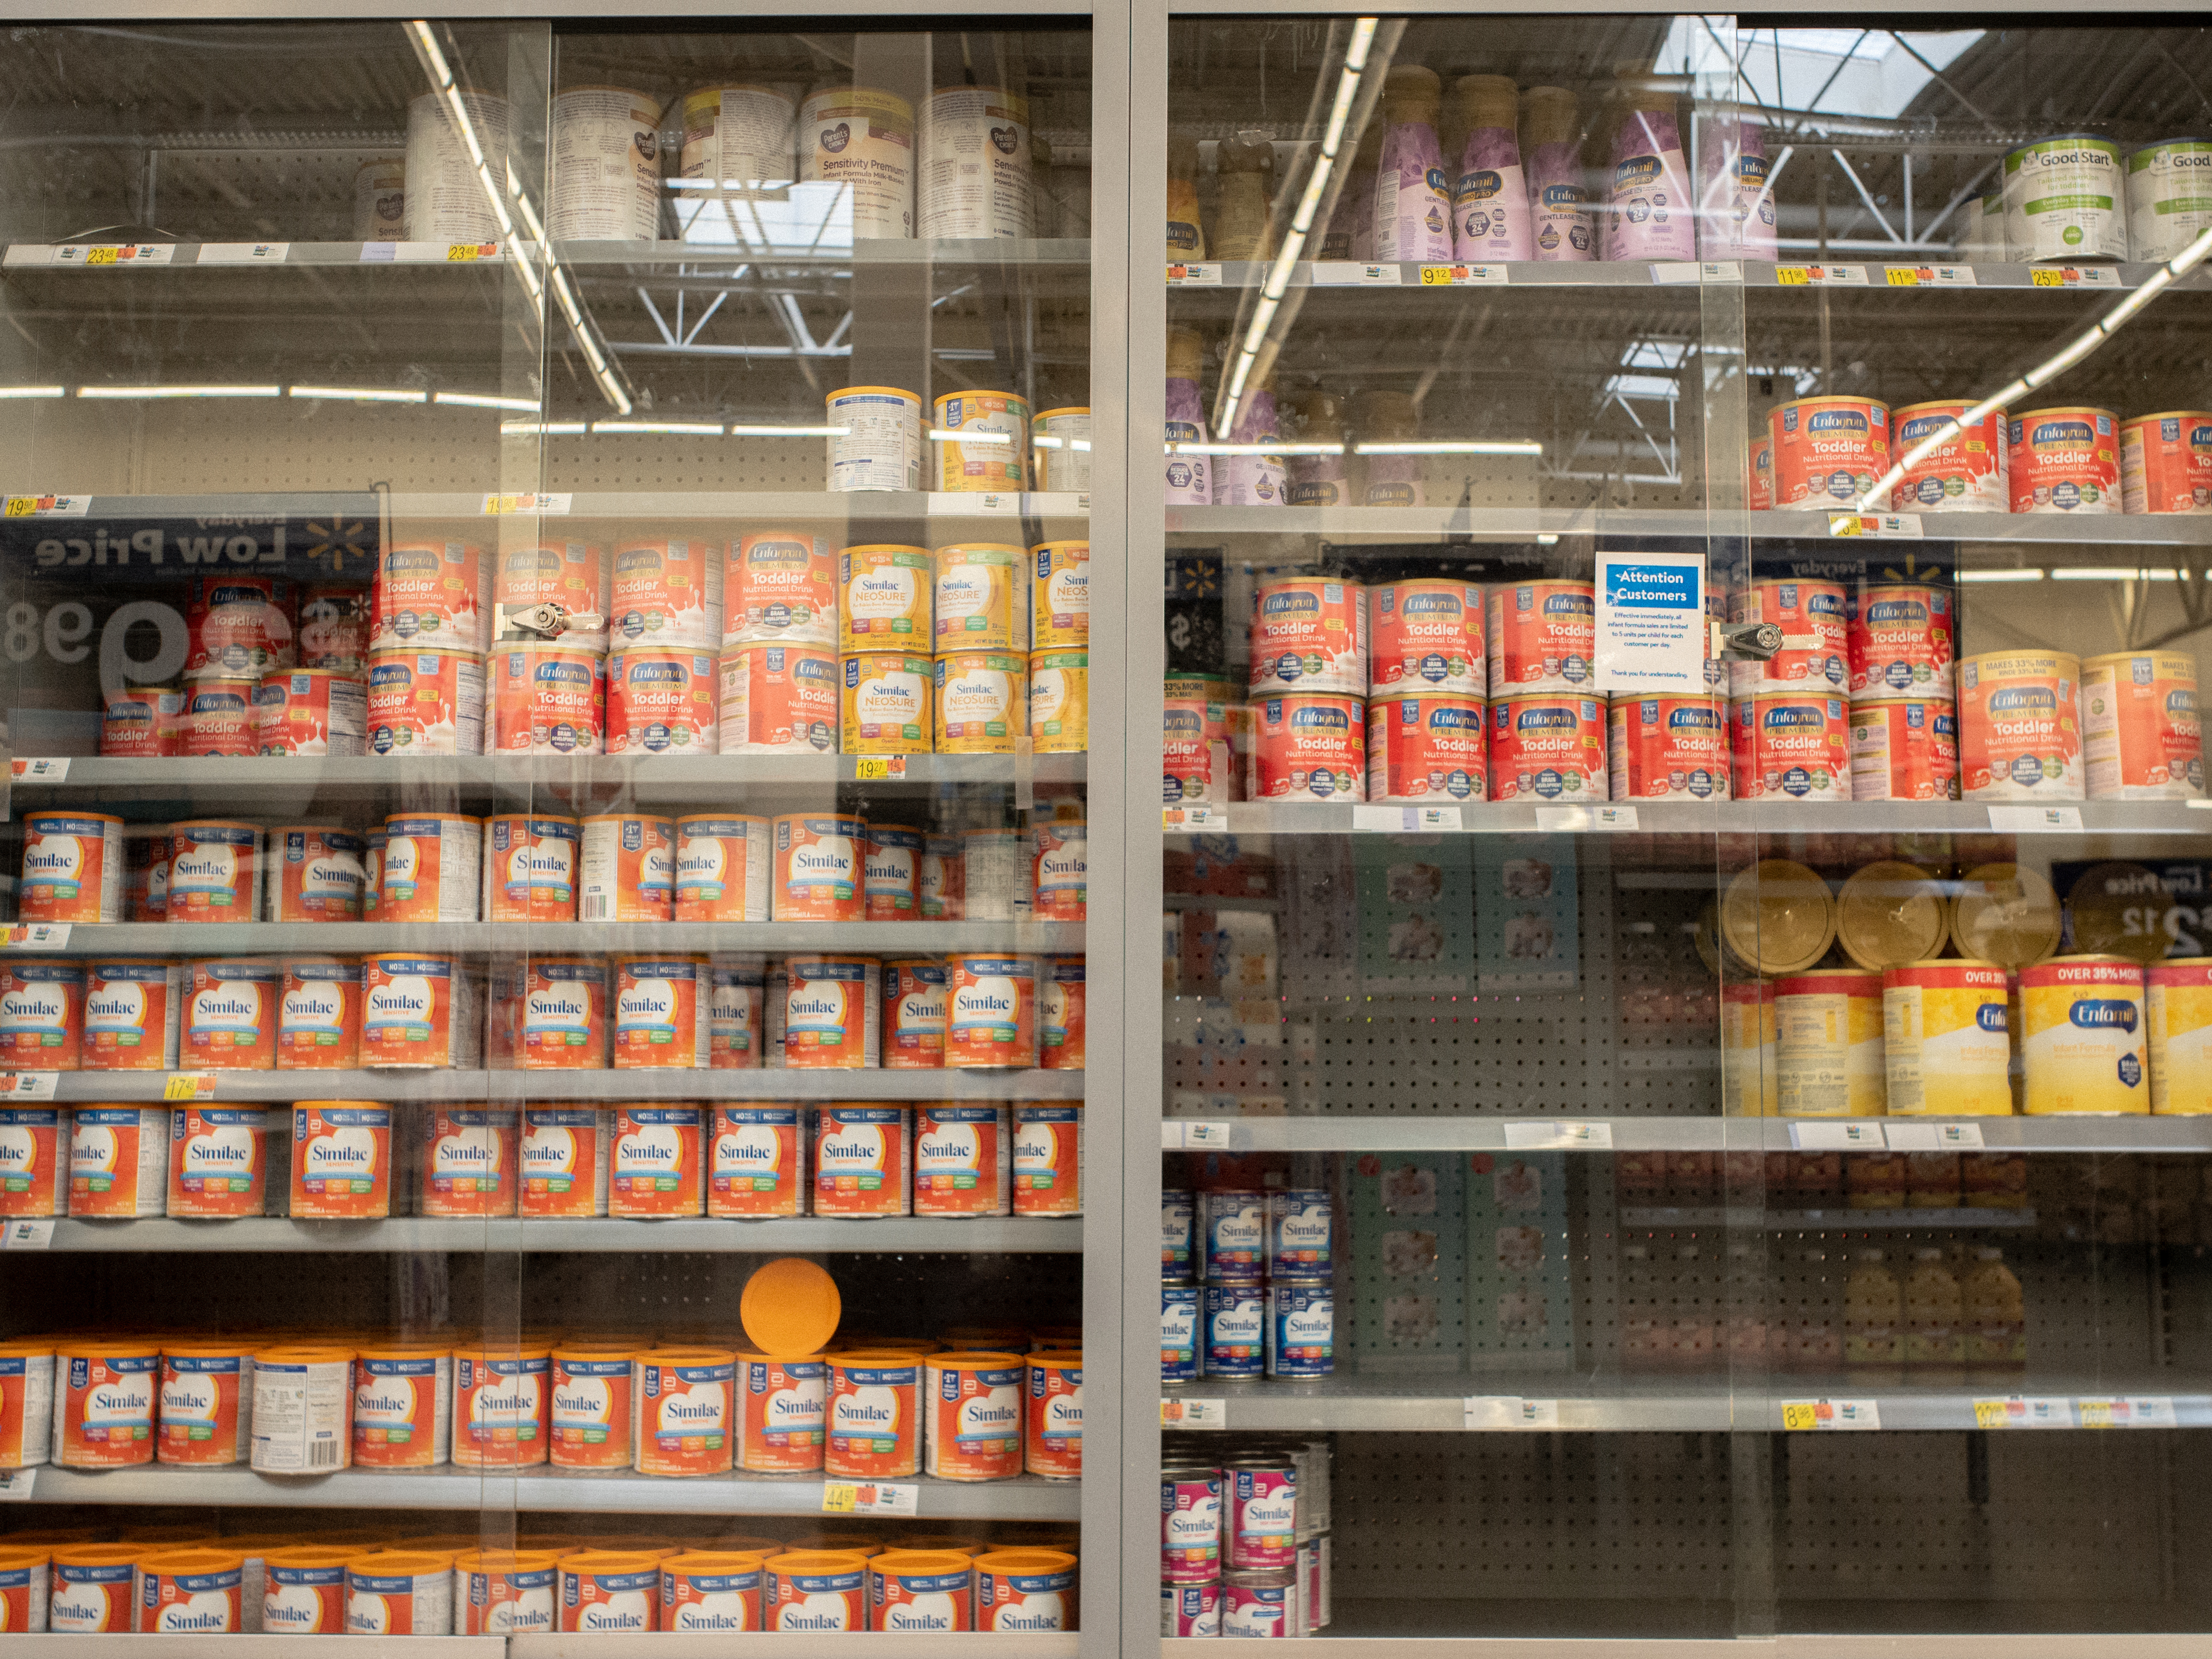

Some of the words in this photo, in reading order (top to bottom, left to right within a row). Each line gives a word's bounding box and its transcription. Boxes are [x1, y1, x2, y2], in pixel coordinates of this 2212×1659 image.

[824, 128, 848, 142] Parent's
[828, 139, 845, 148] CHOICE
[824, 158, 868, 170] Sensitivity
[2041, 152, 2079, 166] Good
[2082, 151, 2109, 165] Start
[2173, 155, 2210, 167] Good
[873, 172, 904, 185] Milk-Based
[994, 171, 1011, 179] Infant
[994, 178, 1016, 188] Powder
[87, 250, 104, 264] 23
[449, 247, 465, 260] 23
[1424, 269, 1433, 283] 9
[1780, 270, 1794, 284] 11
[1889, 270, 1903, 284] 11
[2033, 271, 2051, 286] 25
[1811, 440, 1867, 453] Toddler
[2035, 452, 2092, 465] Toddler
[9, 500, 23, 515] 19
[751, 573, 805, 584] Toddler
[1620, 570, 1683, 583] Attention
[385, 581, 436, 592] Toddler
[791, 585, 813, 594] Drink
[862, 580, 899, 591] Similac
[420, 592, 444, 601] Drink
[1617, 588, 1686, 601] Customers
[1266, 594, 1316, 611] Enfagrow
[1407, 597, 1459, 612] Enfagrow
[1265, 622, 1317, 635] Toddler
[1406, 624, 1460, 635] Toddler
[1398, 636, 1446, 644] Nutritional
[1870, 630, 1925, 643] Toddler
[1986, 661, 2013, 671] MAKES
[2015, 659, 2033, 669] 33%
[633, 667, 686, 684] Enfagrow
[873, 685, 910, 696] Similac
[956, 685, 993, 695] Similac
[538, 693, 588, 706] Toddler
[632, 693, 685, 705] Toddler
[624, 706, 669, 714] Nutritional
[1297, 710, 1345, 726] Enfagrow
[1522, 713, 1574, 727] Enfagrow
[1993, 721, 2055, 735] Toddler
[1295, 737, 1346, 750] Toddler
[1520, 740, 1574, 750] Toddler
[1767, 737, 1822, 750] Toddler
[1513, 752, 1559, 760] Nutritional
[859, 762, 874, 778] 19
[874, 762, 883, 771] 27
[25, 854, 72, 869] Similac
[177, 861, 227, 876] Similac
[797, 854, 848, 869] Similac
[1966, 972, 1992, 983] OVER
[2058, 968, 2090, 979] OVER
[2093, 967, 2118, 979] 35%
[4, 1000, 58, 1016] Similac
[88, 1000, 135, 1015] Similac
[198, 999, 252, 1015] Similac
[285, 1000, 333, 1015] Similac
[372, 995, 423, 1011] Similac
[530, 999, 582, 1014] Similac
[620, 997, 666, 1013] Similac
[790, 999, 836, 1014] Similac
[958, 995, 1010, 1011] Similac
[2078, 1006, 2133, 1023] Enfamil
[191, 1144, 246, 1161] Similac
[312, 1145, 368, 1162] Similac
[621, 1143, 672, 1159] Similac
[719, 1143, 770, 1159] Similac
[825, 1143, 875, 1158] Similac
[921, 1142, 969, 1157] Similac
[1286, 1224, 1326, 1236] Similac
[1291, 1319, 1330, 1331] Similac
[96, 1392, 147, 1409] Similac
[358, 1395, 405, 1411] Similac
[555, 1394, 600, 1411] Similac
[668, 1402, 719, 1418] Similac
[838, 1403, 890, 1420] Similac
[1249, 1507, 1291, 1521] Similac
[1172, 1519, 1215, 1532] Similac
[167, 1613, 223, 1630] Similac
[587, 1612, 643, 1629] Similac
[784, 1612, 840, 1629] Similac
[891, 1612, 948, 1629] Similac
[1001, 1612, 1058, 1629] Similac
